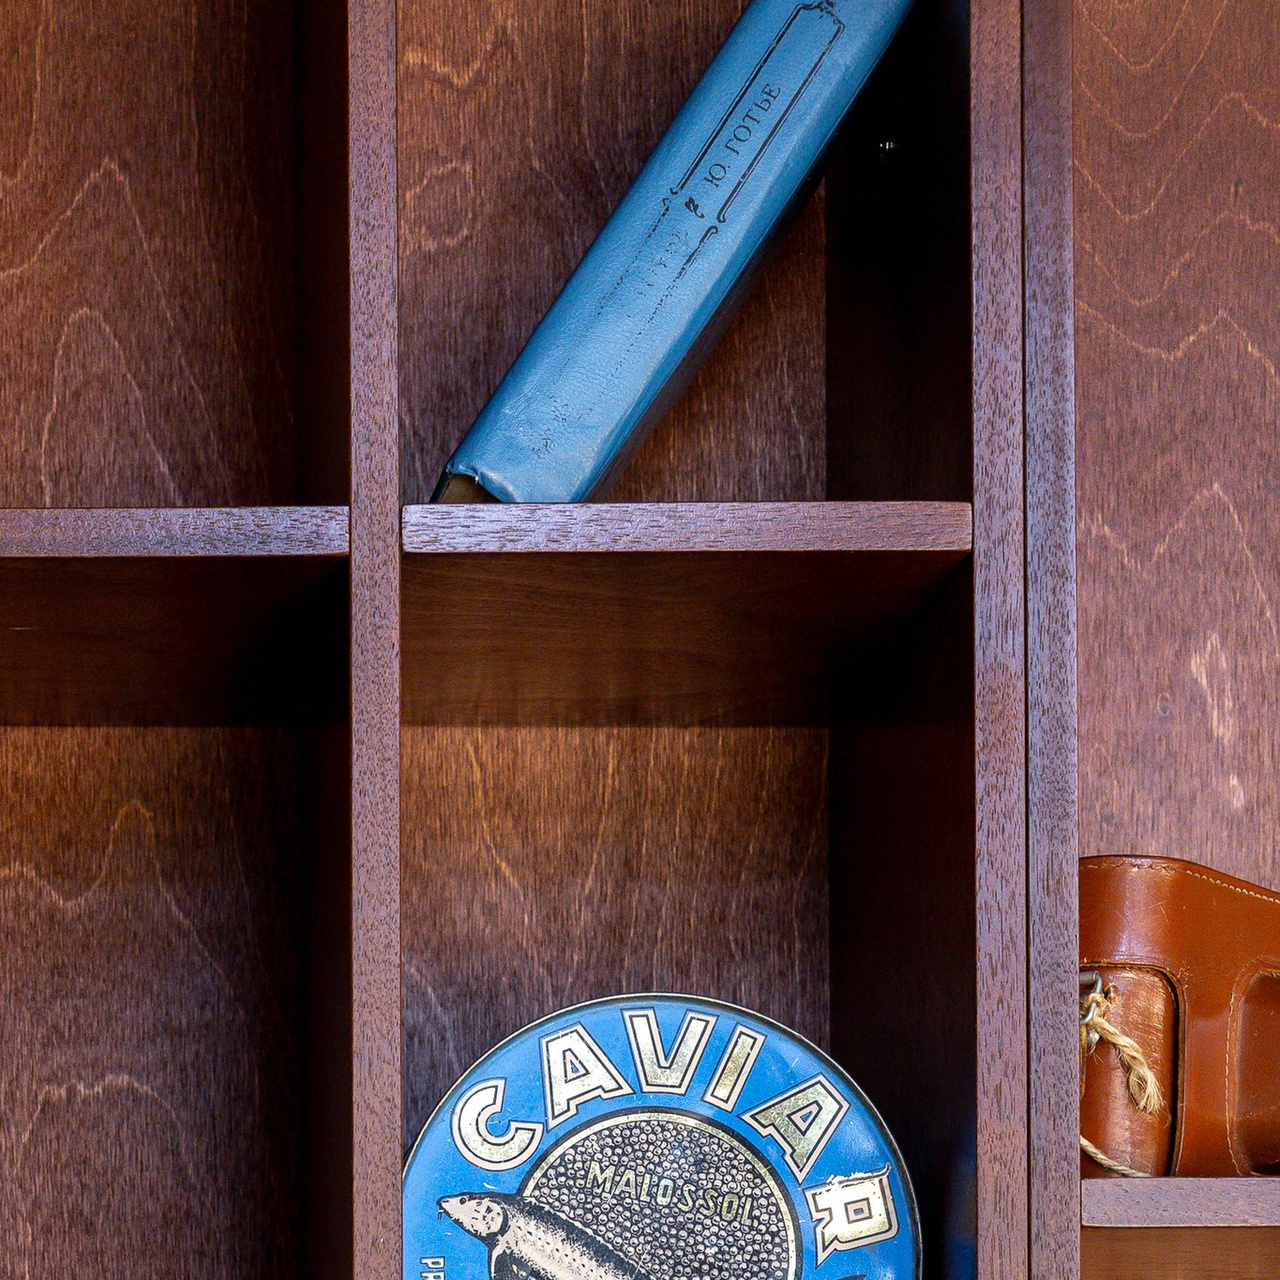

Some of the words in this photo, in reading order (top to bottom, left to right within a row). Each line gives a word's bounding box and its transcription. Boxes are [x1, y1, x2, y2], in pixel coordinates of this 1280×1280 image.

[703, 163, 731, 189] Ю.
[724, 83, 781, 156] ГОТЬЕ
[451, 1006, 900, 1268] CAVIAR
[585, 1160, 755, 1227] MALOSSOL
